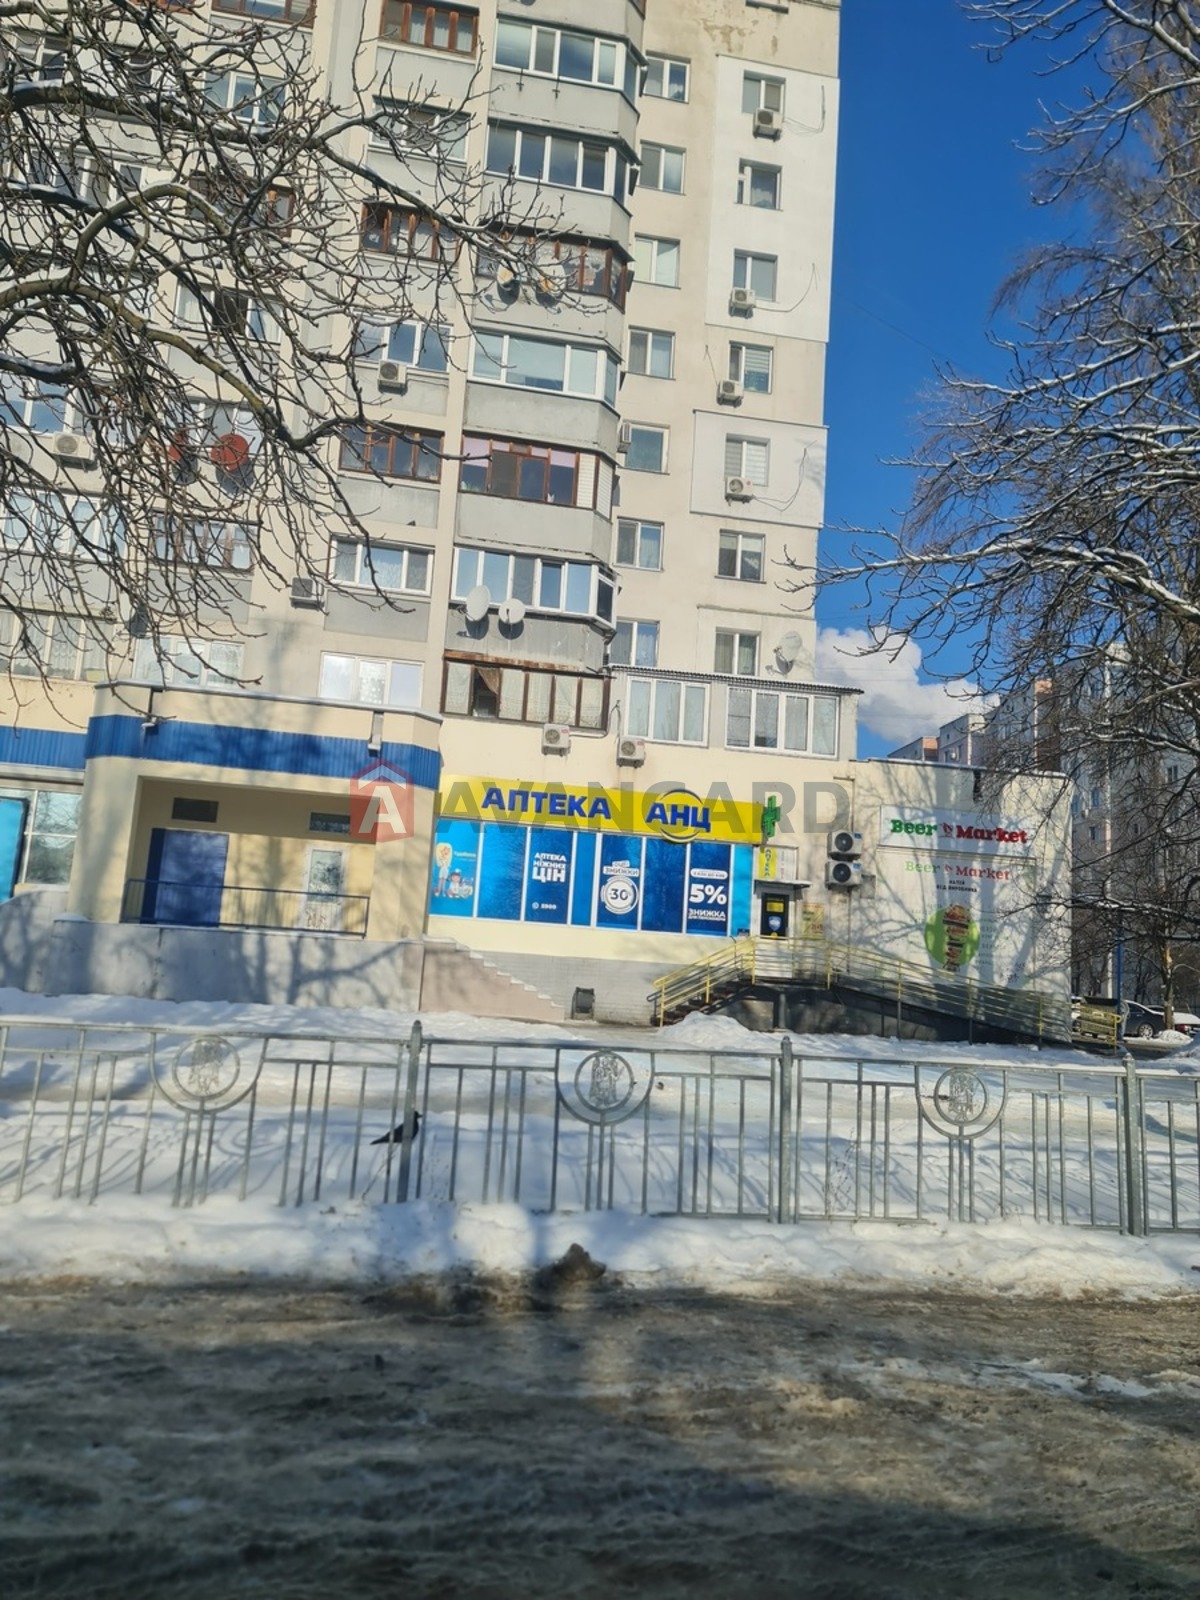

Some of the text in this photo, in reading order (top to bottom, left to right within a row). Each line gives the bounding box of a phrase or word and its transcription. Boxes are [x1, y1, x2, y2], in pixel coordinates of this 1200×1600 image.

[481, 787, 711, 832] АПТЕКА АНЦ
[890, 819, 1028, 844] Beer Market
[534, 852, 567, 862] АПТЕКА
[532, 866, 566, 883] ЦІН
[905, 861, 1011, 880] Beer Market
[689, 883, 728, 905] 5%
[688, 907, 726, 918] ЗНИЖКА
